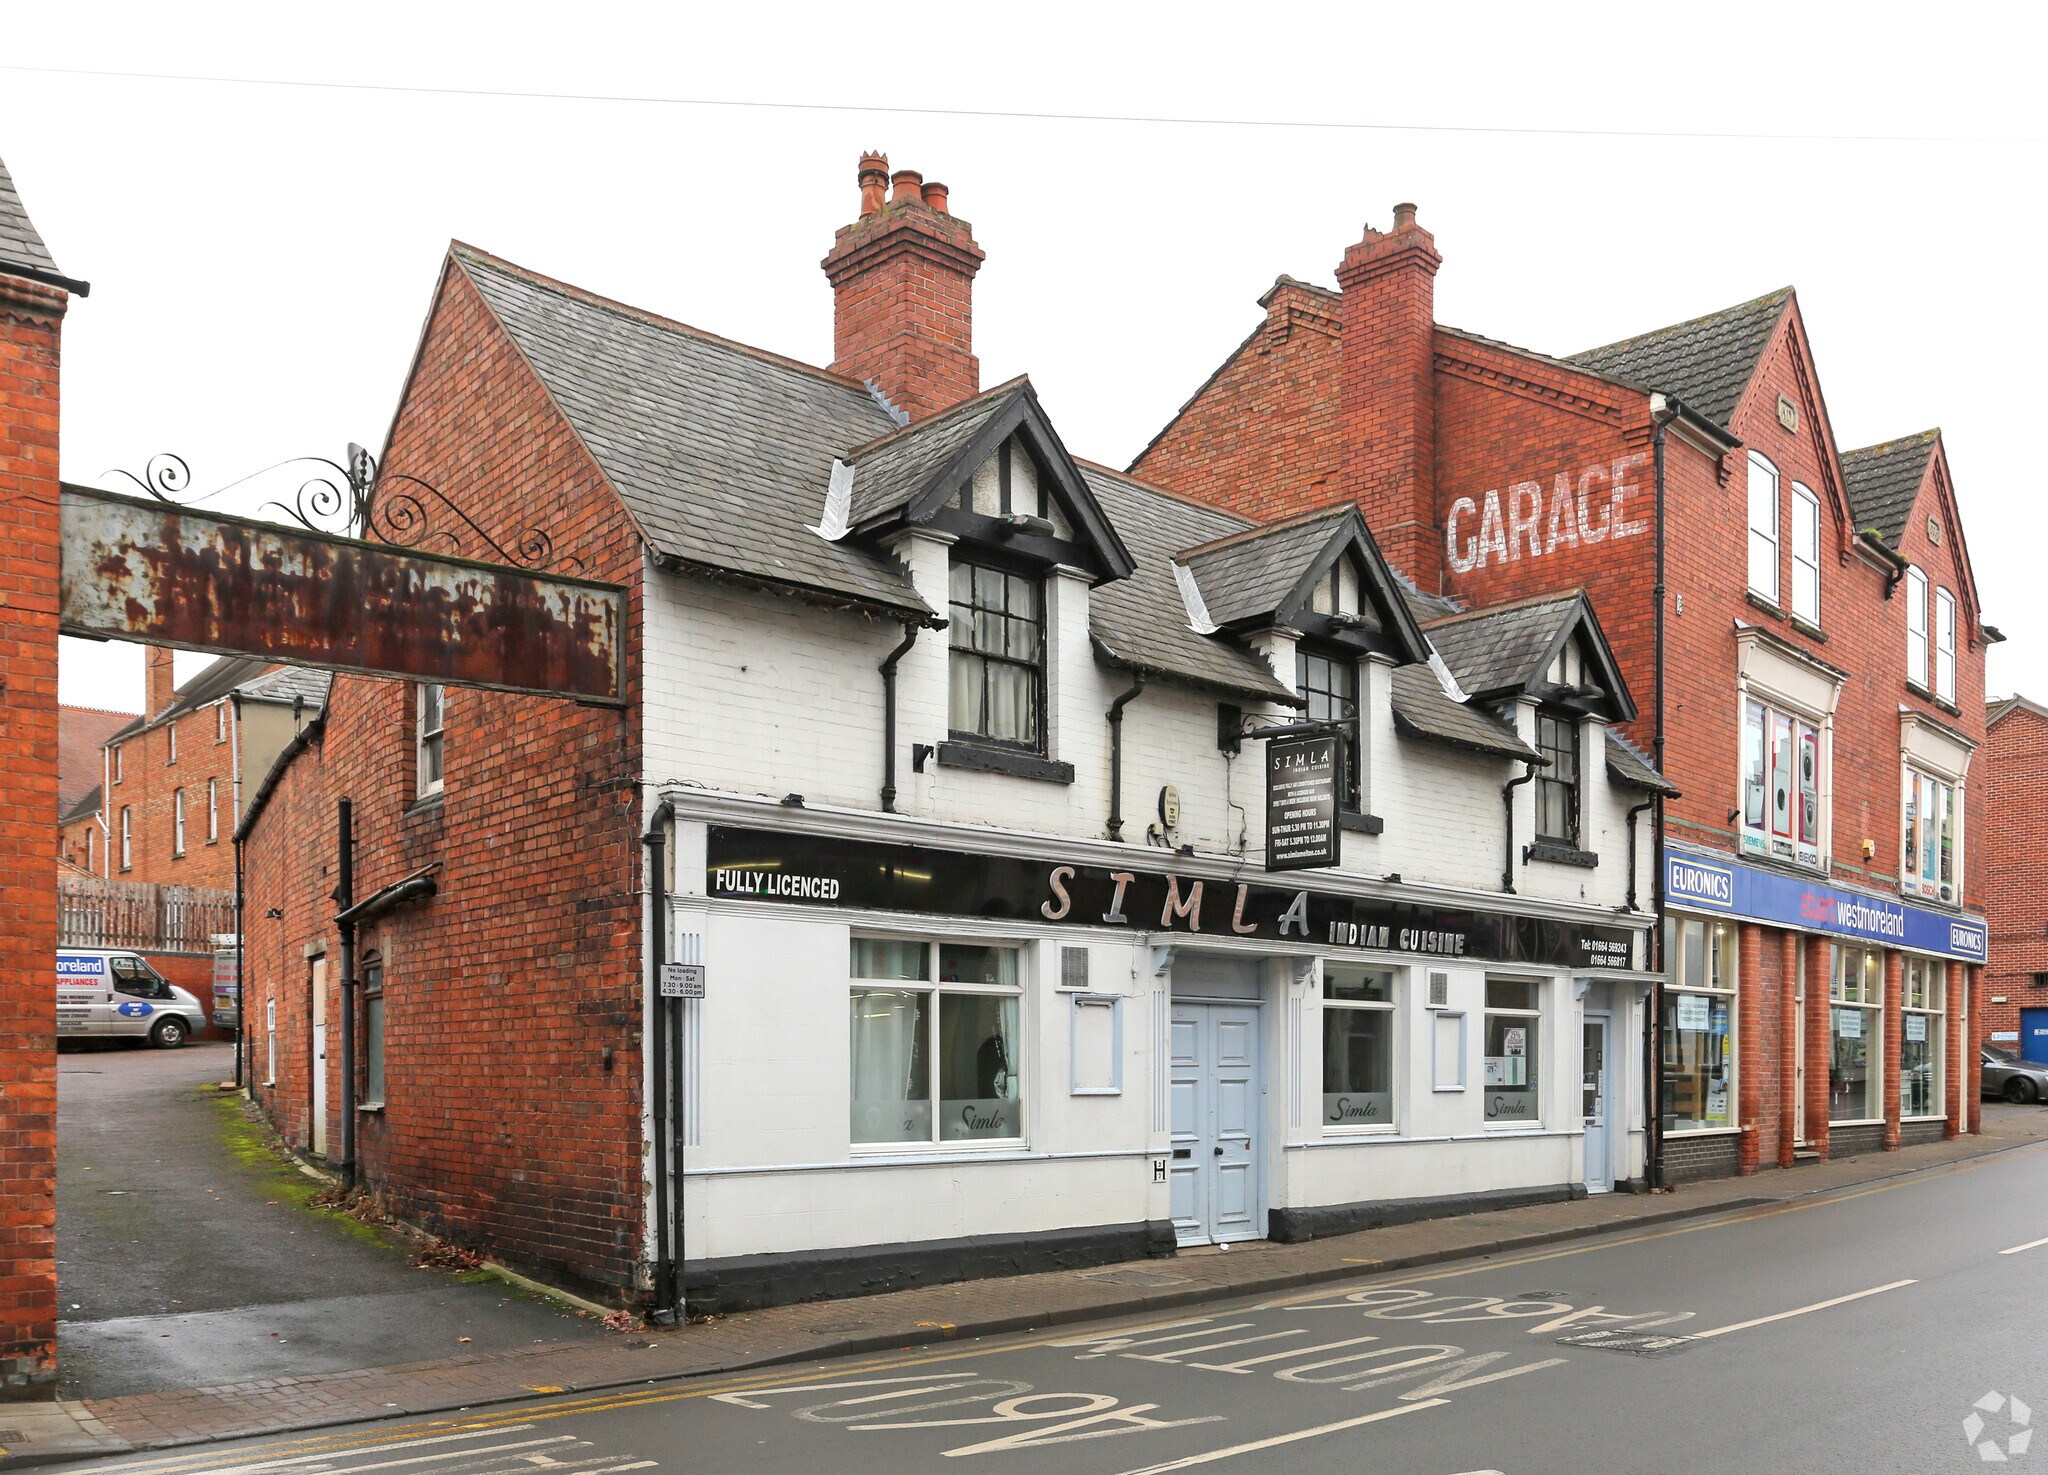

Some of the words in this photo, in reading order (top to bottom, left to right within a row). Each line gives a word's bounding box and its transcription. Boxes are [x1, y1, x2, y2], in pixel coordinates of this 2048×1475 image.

[1447, 452, 1649, 574] GARAGE
[1274, 750, 1328, 770] SIMLA
[1284, 810, 1301, 819] OPENING
[1302, 808, 1316, 817] HOURS
[1272, 825, 1291, 834] SUN-THUR
[1275, 838, 1289, 847] FRI-SAT
[1304, 835, 1309, 844] TO
[1744, 835, 1766, 849] SIEMENS
[1800, 852, 1816, 864] BEKO
[716, 869, 763, 893] FULLY
[767, 873, 840, 900] LICENCED
[1673, 865, 1728, 899] EURONICS
[1922, 883, 1936, 895] BOSCH
[1041, 866, 1310, 936] SIMLA
[1801, 891, 1835, 923] stuart
[1837, 901, 1904, 937] westmoreland
[1329, 921, 1389, 947] INDIAN
[1400, 928, 1465, 954] CUISINE
[1592, 940, 1607, 951] 01664
[1953, 928, 1981, 951] EURONICS
[56, 958, 102, 972] oreland
[1591, 954, 1606, 966] 01664
[1329, 1097, 1377, 1121] Simla
[1487, 1096, 1526, 1117] Simla
[955, 1105, 1006, 1134] Simla
[1154, 1160, 1165, 1180] H
[708, 1371, 1228, 1458] A607
